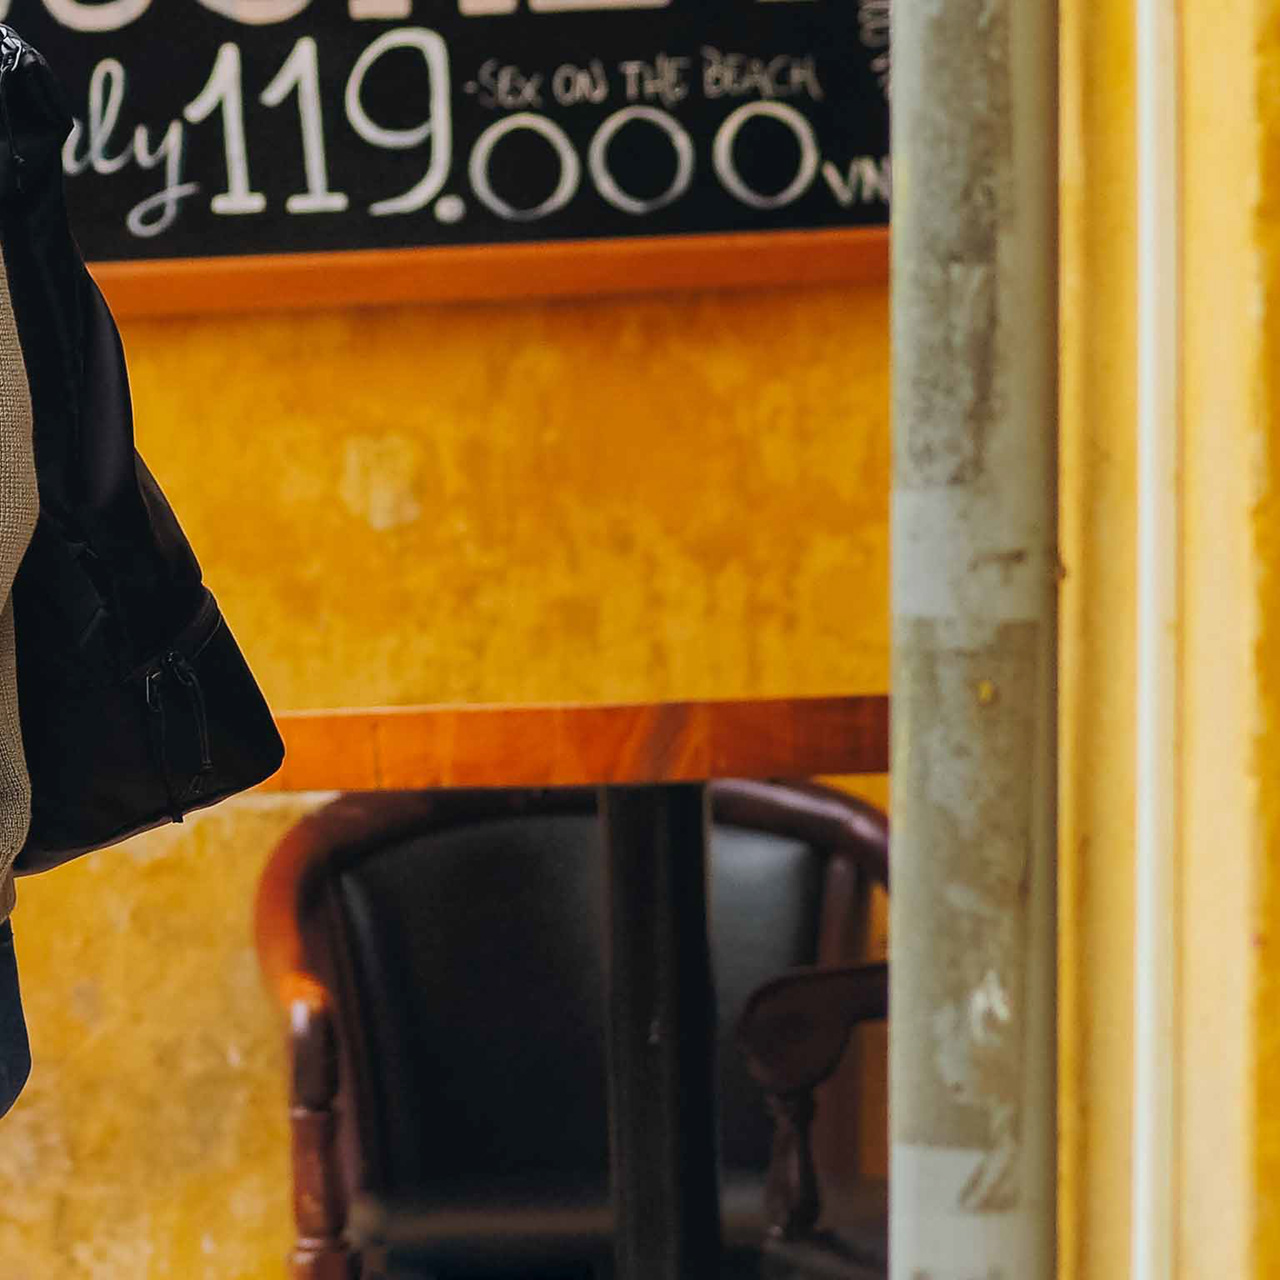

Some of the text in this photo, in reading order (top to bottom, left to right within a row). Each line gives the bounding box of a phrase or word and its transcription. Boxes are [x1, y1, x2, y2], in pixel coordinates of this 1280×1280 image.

[618, 50, 691, 109] THE
[62, 57, 202, 238] ly
[821, 154, 890, 208] VN
